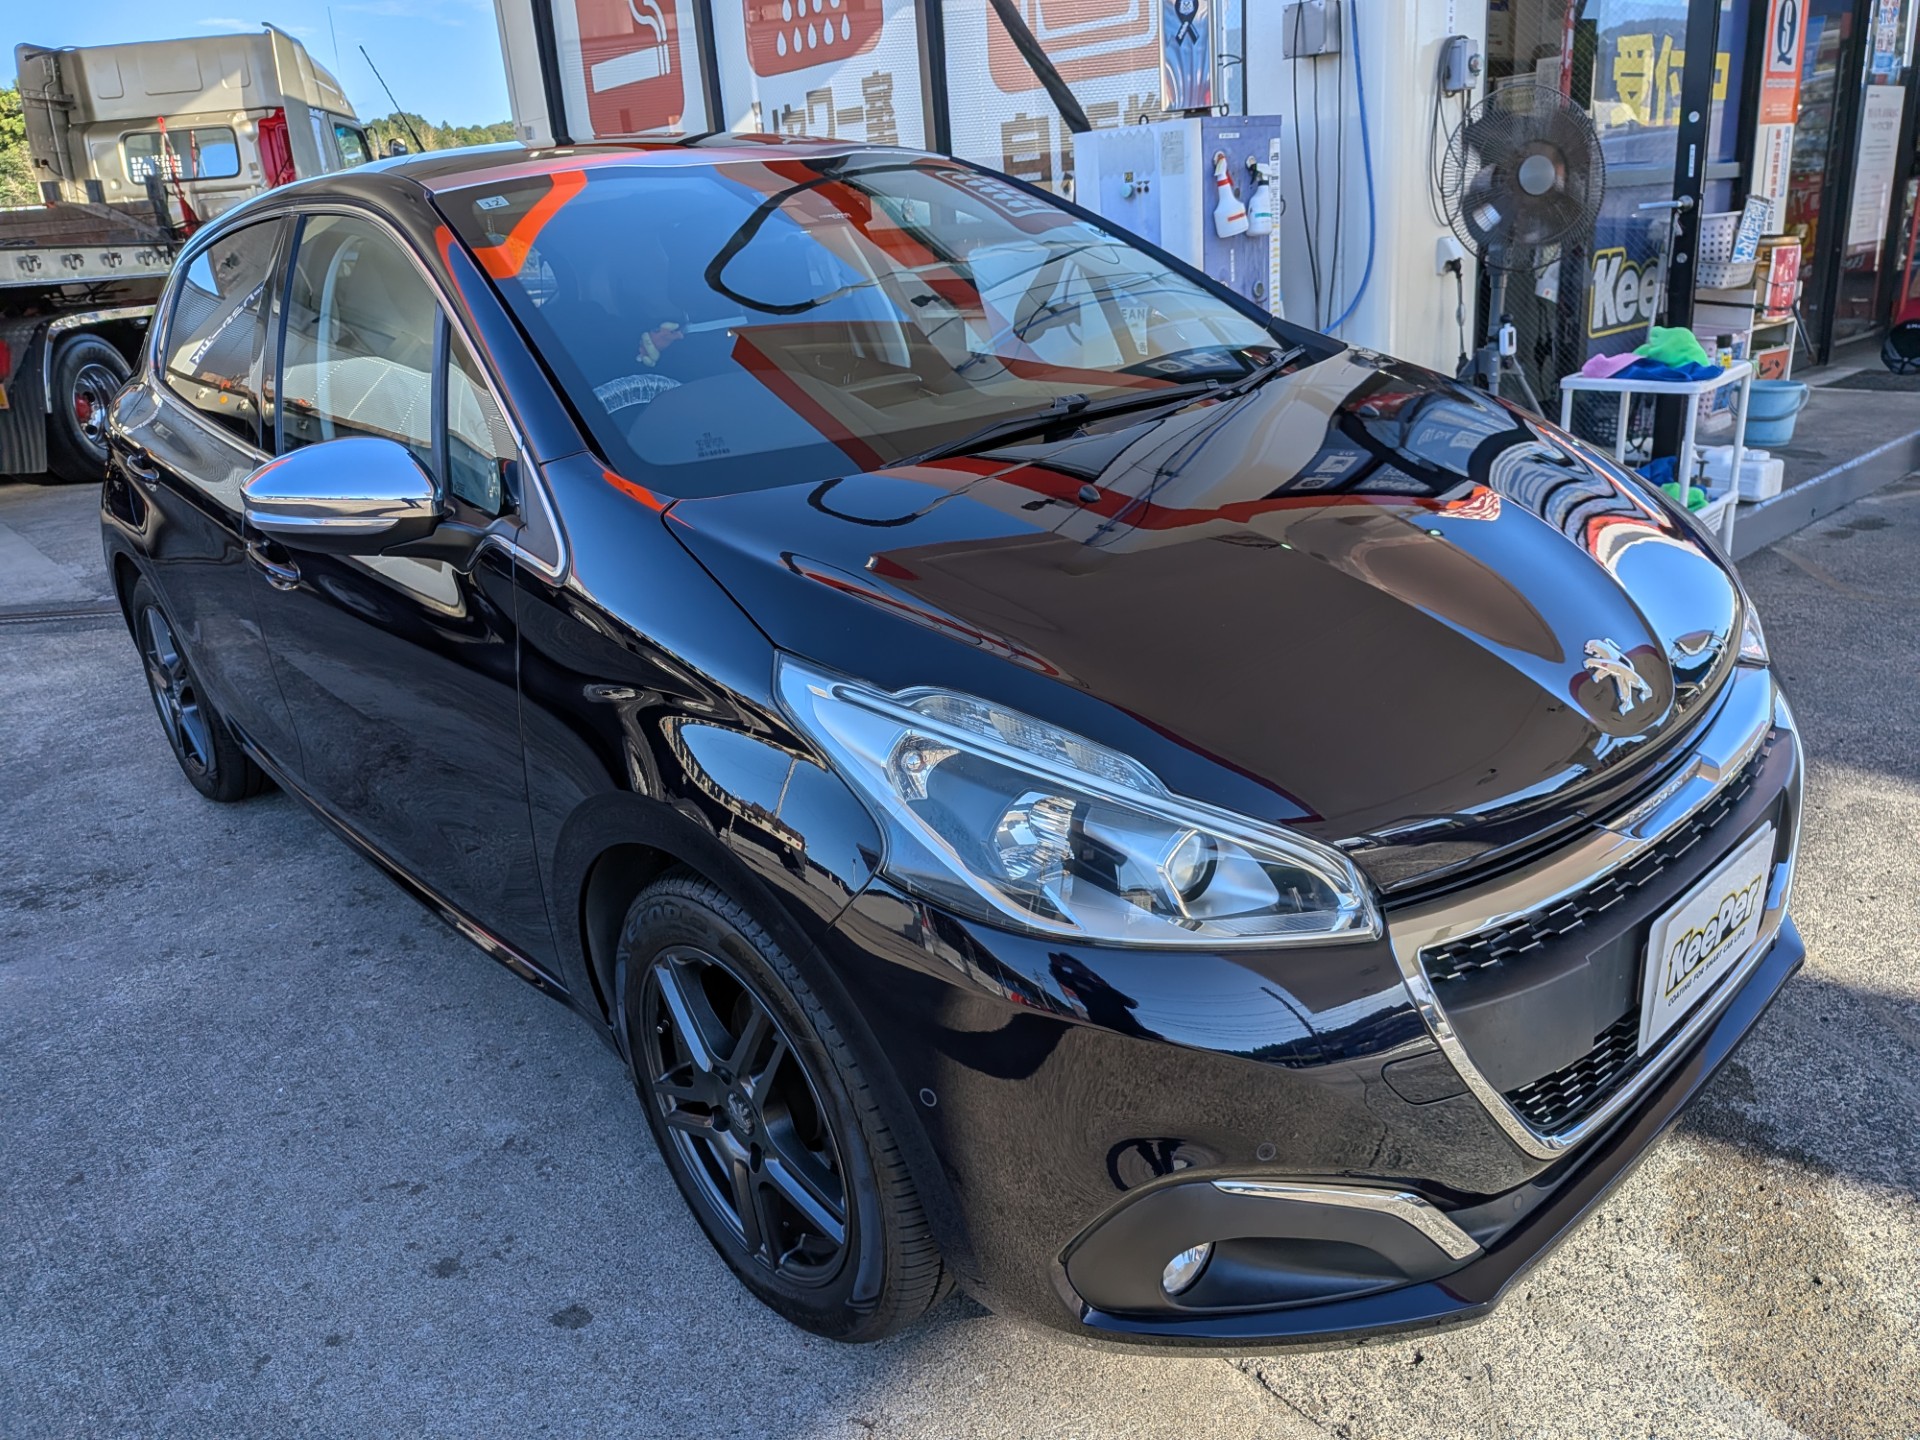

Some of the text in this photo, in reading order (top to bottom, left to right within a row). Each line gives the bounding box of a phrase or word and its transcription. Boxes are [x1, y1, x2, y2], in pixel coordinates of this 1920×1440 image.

[1665, 875, 1762, 997] KeePer
[1668, 926, 1746, 1007] COATING FOR SMART CAR LIFE
